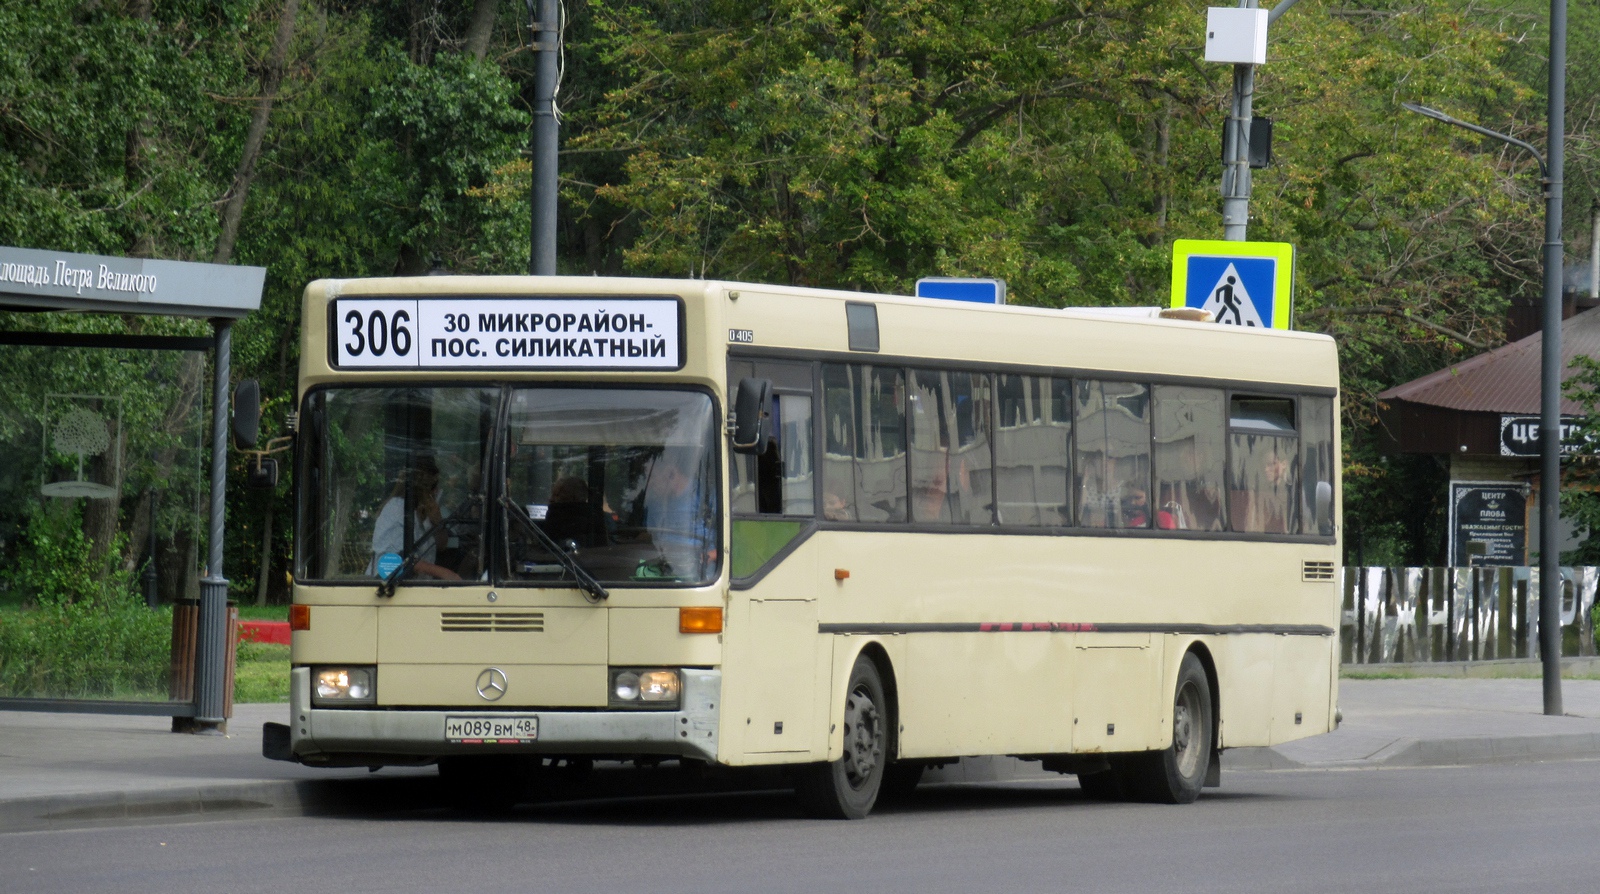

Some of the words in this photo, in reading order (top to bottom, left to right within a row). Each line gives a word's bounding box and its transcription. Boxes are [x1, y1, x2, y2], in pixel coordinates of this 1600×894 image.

[53, 260, 93, 294] Петра
[96, 264, 157, 293] Великого
[443, 313, 471, 333] 30
[478, 308, 654, 333] МИКРОРАЙОН-
[344, 309, 412, 358] 306
[736, 330, 753, 342] 405
[430, 339, 488, 358] ПОС.
[498, 334, 667, 358] СИЛИКАТНЫЙ
[1512, 423, 1582, 444] ЦЕТР
[1481, 492, 1506, 500] ЦЕНТР
[516, 720, 531, 732] 48
